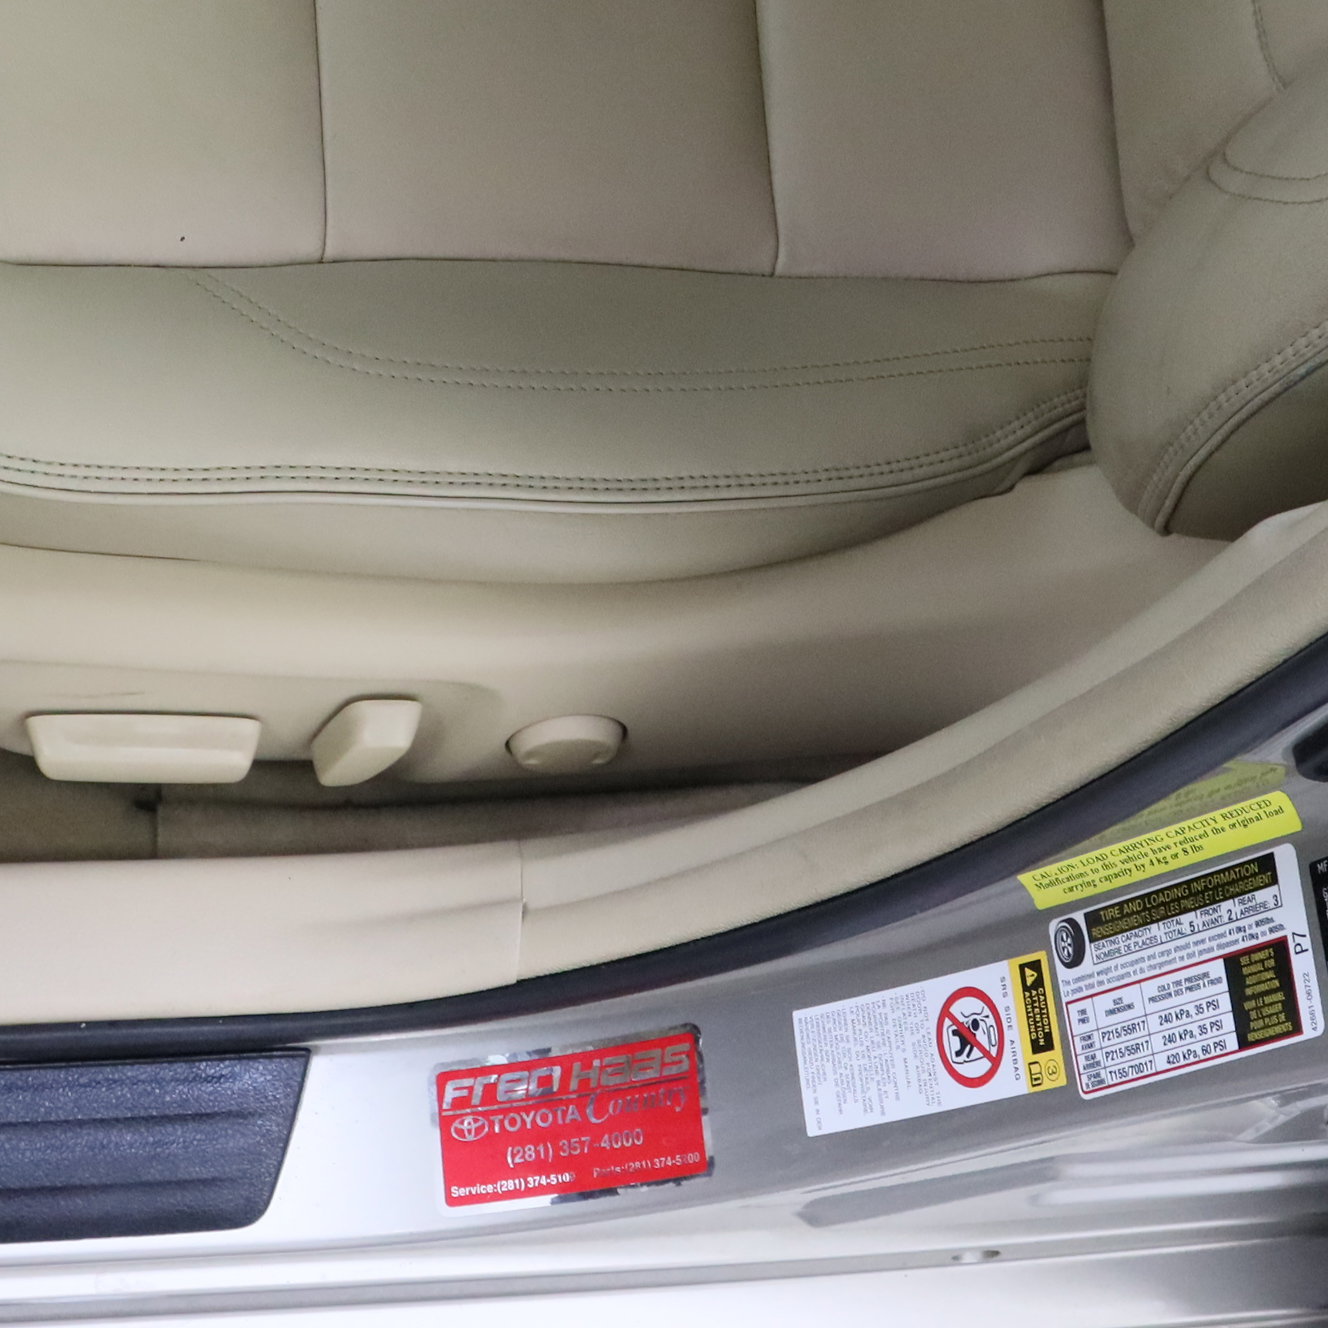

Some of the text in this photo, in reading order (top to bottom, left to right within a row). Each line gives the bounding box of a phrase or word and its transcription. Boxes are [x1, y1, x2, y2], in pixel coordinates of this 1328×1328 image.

[1034, 867, 1089, 892] Modifications
[1099, 858, 1118, 871] this
[1116, 848, 1150, 865] vehicle
[1148, 841, 1172, 855] have
[1171, 829, 1210, 847] reduced
[1208, 823, 1227, 835] the
[1225, 811, 1265, 832] original
[1262, 804, 1285, 818] load
[1079, 798, 1273, 867] LOAD CARRYING CAPACITY REDUCED
[1061, 878, 1098, 897] carrying
[1096, 865, 1135, 885] capacity
[1133, 861, 1149, 873] by
[1153, 854, 1170, 867] kg
[1189, 842, 1205, 853] lbs
[1100, 859, 1259, 923] TIRE AND LOADING INFORMATION
[1090, 909, 1151, 941] RENSEIGNEMENTS
[1165, 901, 1180, 916] LES
[1179, 892, 1204, 912] PNEUS
[1223, 870, 1273, 898] CHARGEMENT
[1093, 893, 1256, 952] SEATING CAPACITY TOTAL FRONT REAR
[1071, 969, 1100, 985] combined
[1100, 965, 1113, 978] weight
[1119, 955, 1146, 972] occupants
[1146, 951, 1157, 962] and
[1157, 948, 1173, 960] cargo
[1173, 940, 1191, 953] should
[1192, 936, 1207, 947] never
[1207, 929, 1227, 943] exceed
[1227, 923, 1246, 938] 410kg
[1095, 945, 1123, 962] NOMBRE
[1131, 934, 1158, 951] PLACES
[1164, 925, 1186, 940] TOTAL:
[1201, 913, 1225, 929] AVANT:
[1294, 931, 1310, 955] P7
[1147, 990, 1173, 1004] PRESSION
[1156, 982, 1171, 993] COLD
[1183, 971, 1211, 985] PRESSURE
[1021, 990, 1039, 1040] ACHTUNG
[1027, 988, 1047, 1046] ATTENTION
[1034, 987, 1052, 1033] CAUTION
[1100, 1019, 1147, 1043] P215/55R17
[1103, 1001, 1135, 1017] DIMENSIONS
[1157, 998, 1220, 1025] 240 kPa, 35 PSI
[1104, 1039, 1151, 1063] P215/55R17
[1161, 1018, 1224, 1046] 240 kPa, 35 PSI
[1165, 1038, 1227, 1066] 420 kPa, 60 PSI
[439, 1041, 694, 1111] Fred Haas
[1009, 1039, 1021, 1082] AIRBAG
[1108, 1059, 1154, 1082] T155/70D17
[488, 1077, 689, 1136] TOYOTA Country
[505, 1128, 644, 1169] (281) 357-4000
[450, 1176, 525, 1201] Service:(281)
